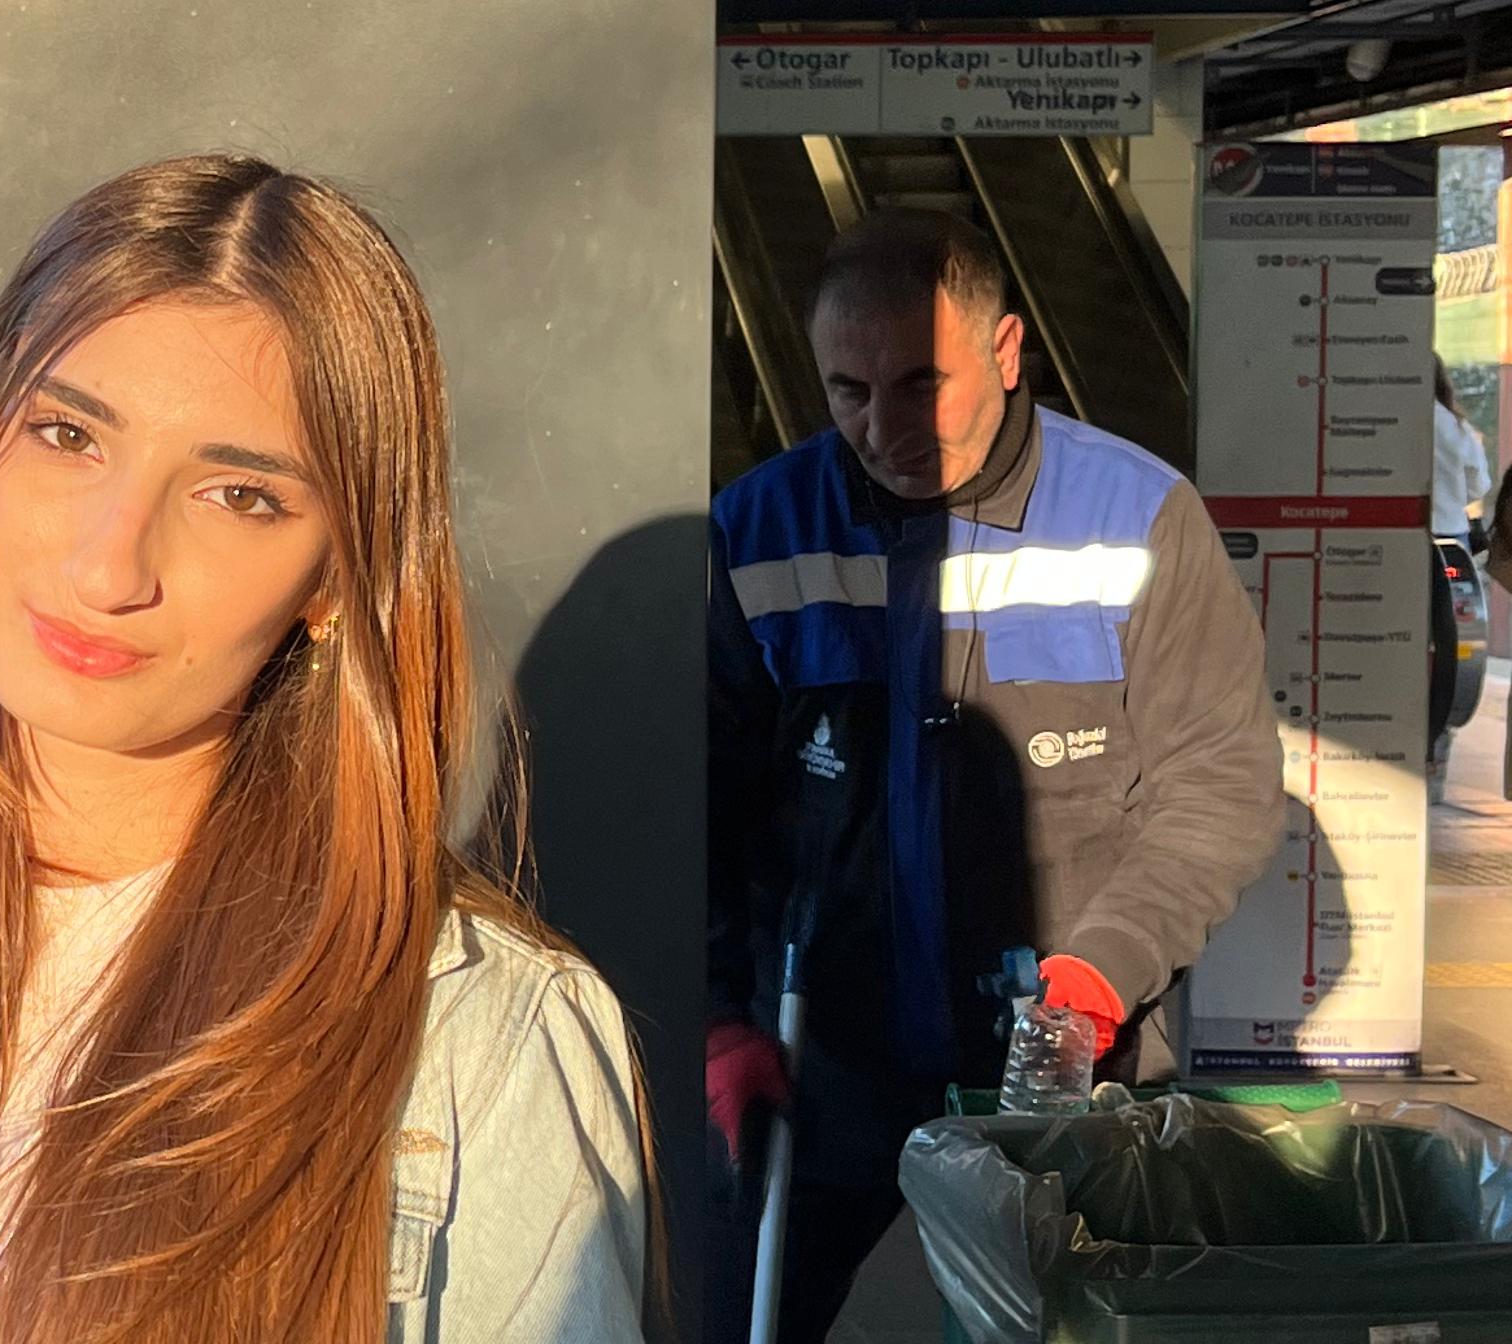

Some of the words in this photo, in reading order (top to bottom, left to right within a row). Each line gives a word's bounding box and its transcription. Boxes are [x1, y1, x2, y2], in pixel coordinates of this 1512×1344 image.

[756, 48, 850, 74] Otogar
[888, 47, 989, 74] Topkapı
[1017, 46, 1120, 69] Ulubatlı
[1006, 90, 1117, 114] Yenikapı
[1280, 506, 1348, 520] Kocatepe
[1278, 1034, 1352, 1047] İSTANBUL
